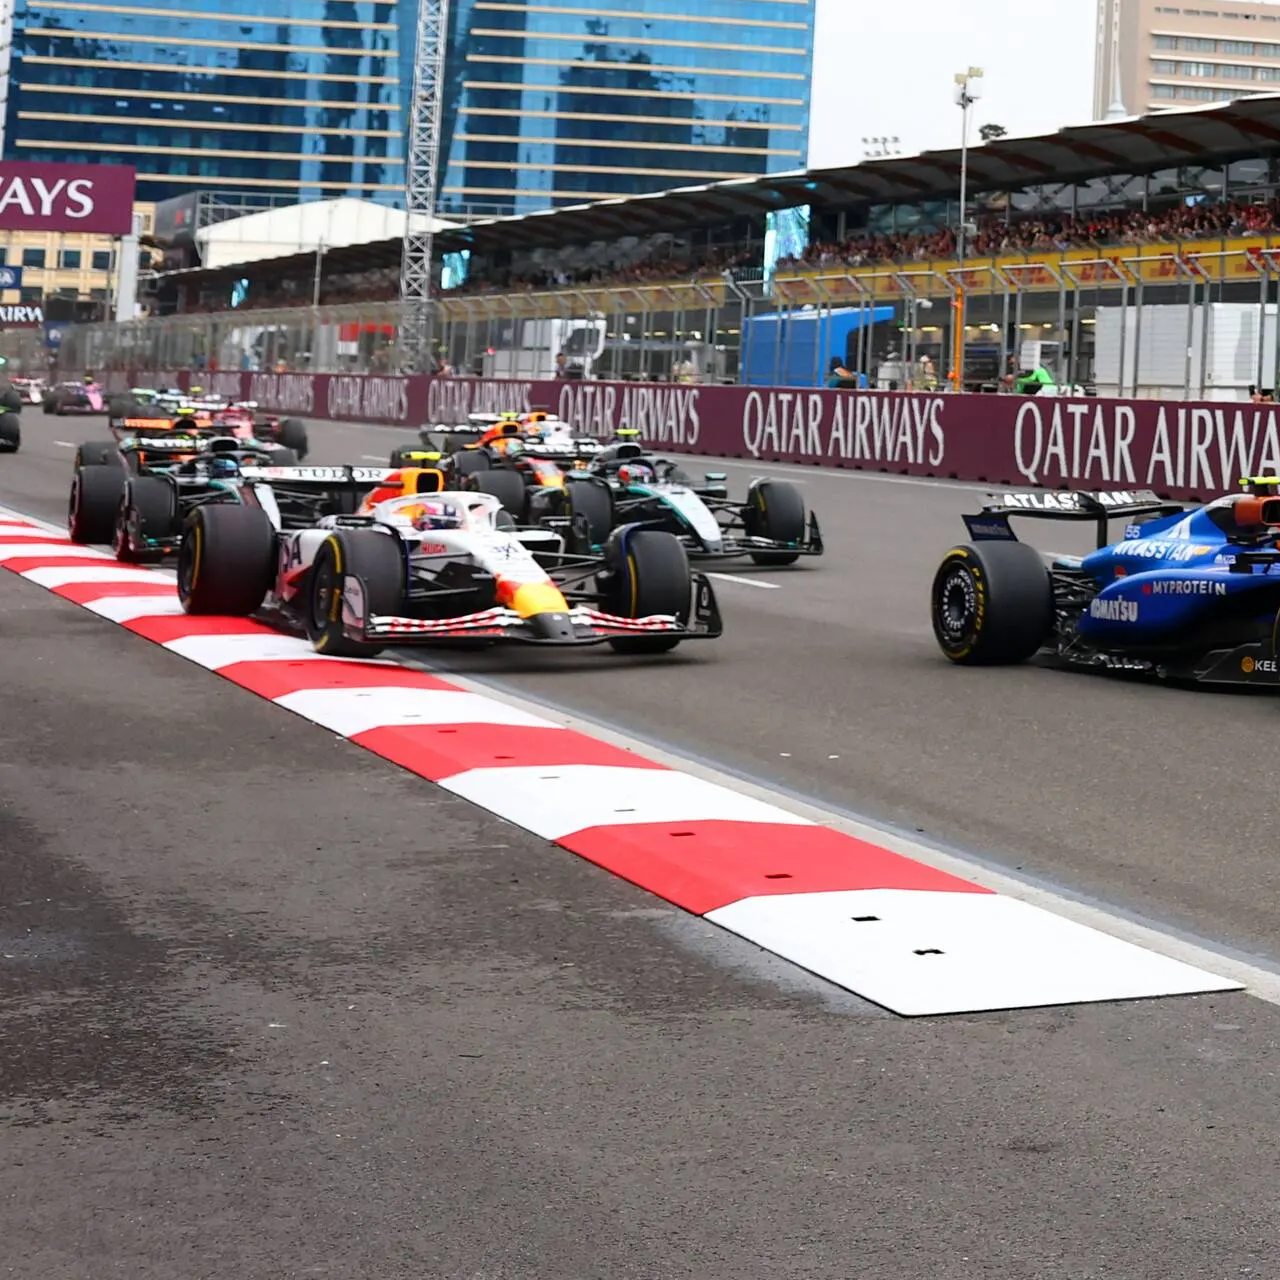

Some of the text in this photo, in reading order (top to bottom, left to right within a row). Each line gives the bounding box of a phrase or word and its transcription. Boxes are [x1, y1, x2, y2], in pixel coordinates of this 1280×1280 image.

[558, 384, 700, 446] QATAR AIRWAYS
[743, 391, 945, 467] QATAR AIRWAYS
[1014, 401, 1137, 485] QATAR
[292, 468, 382, 482] TUDOR
[1125, 525, 1140, 538] 55
[1153, 581, 1227, 596] MYPROTEIN
